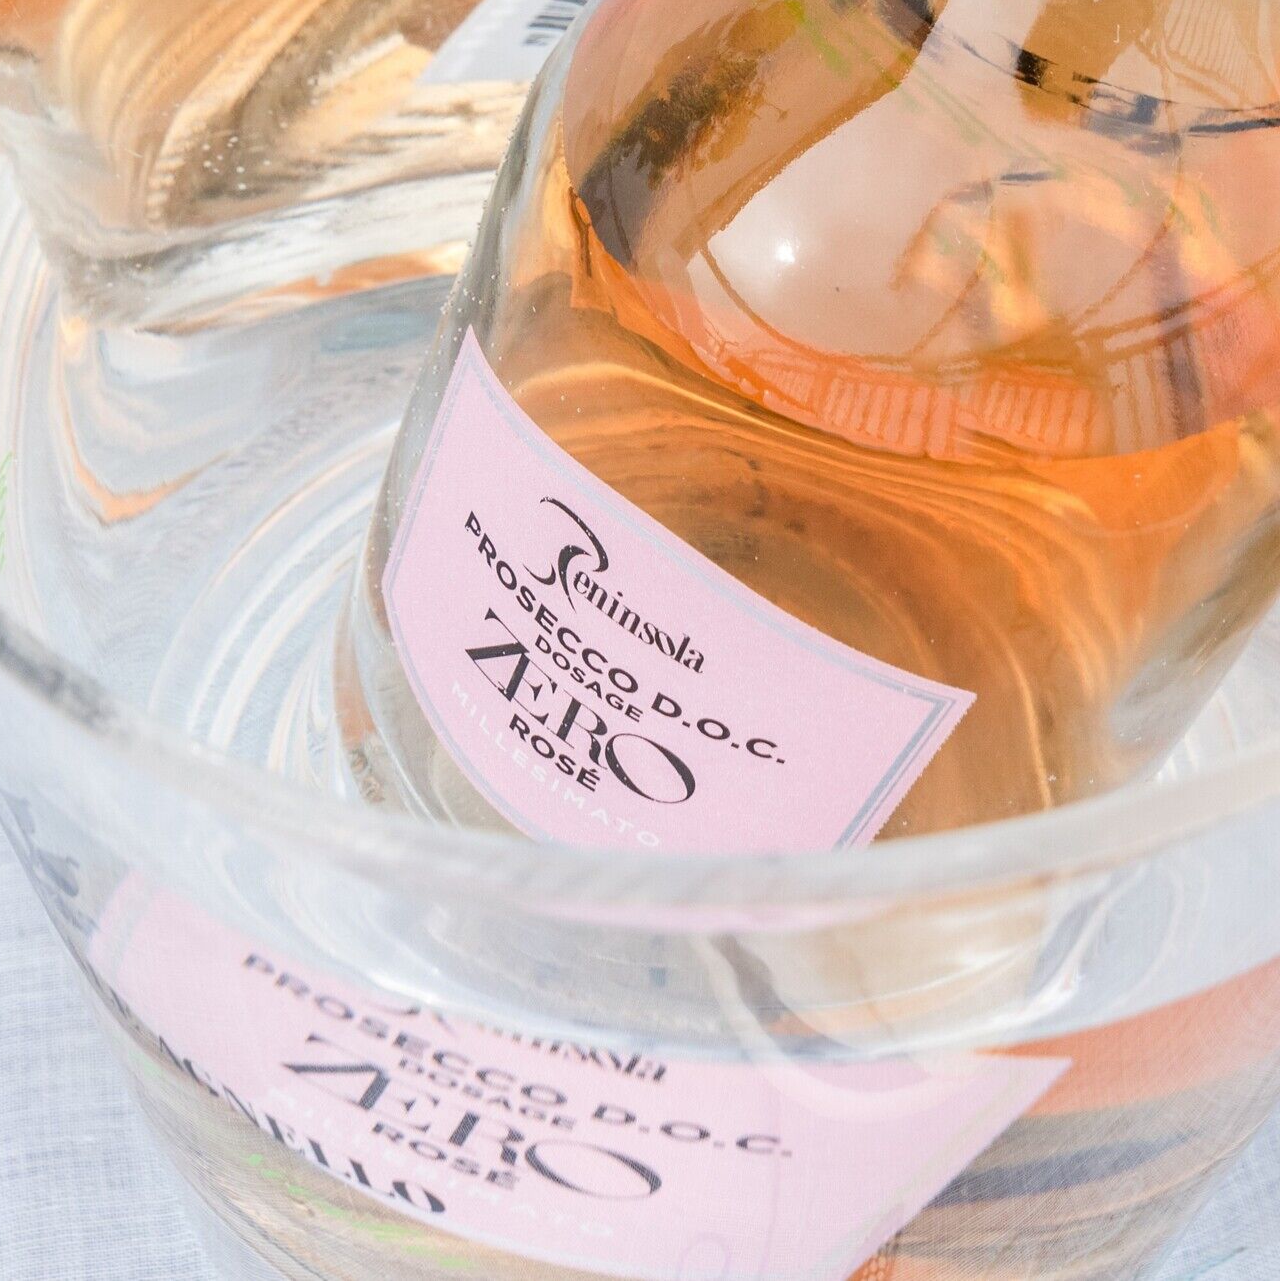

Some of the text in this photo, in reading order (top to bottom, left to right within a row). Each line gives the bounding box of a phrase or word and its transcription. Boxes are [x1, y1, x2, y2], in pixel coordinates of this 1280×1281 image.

[465, 511, 786, 764] PROSECCO D.O.C.
[521, 496, 704, 673] Peninsola
[451, 679, 660, 848] MILLESIMATO
[465, 607, 696, 804] ZERO
[509, 713, 601, 792] ROSÉ
[535, 634, 644, 723] DOSAGE
[243, 953, 567, 1106] PROSECCO
[593, 1103, 793, 1157] D.O.C.
